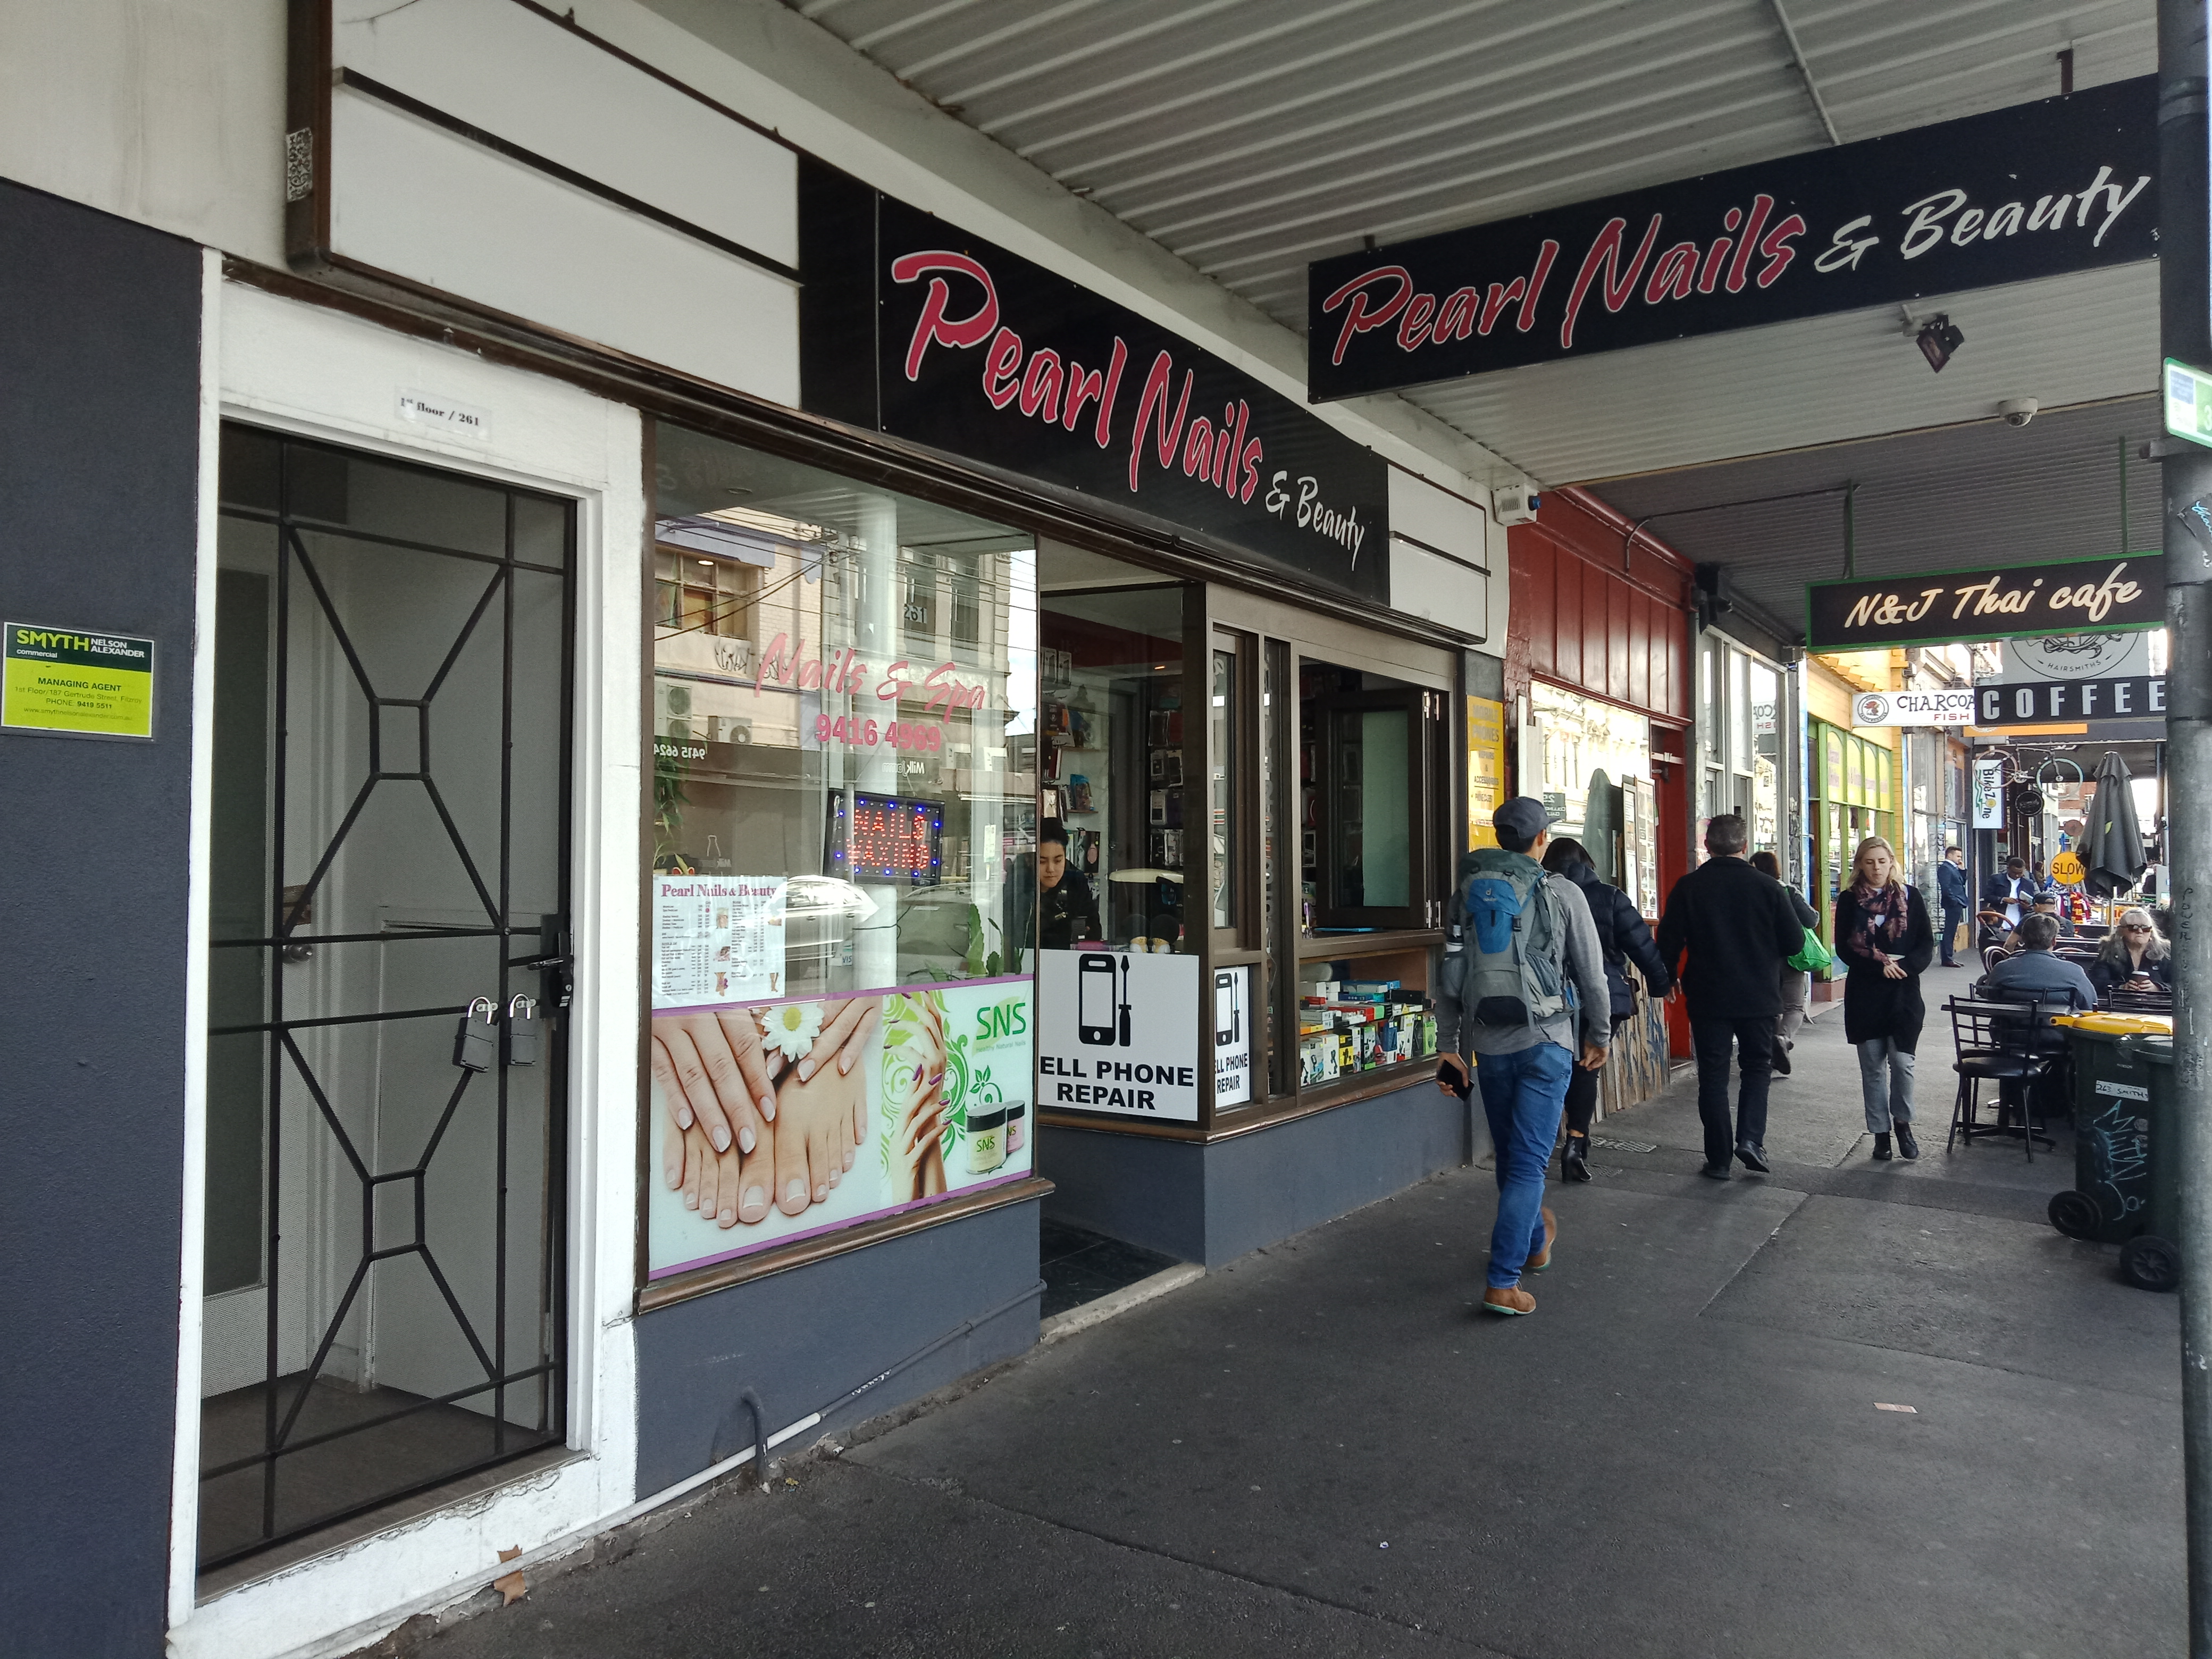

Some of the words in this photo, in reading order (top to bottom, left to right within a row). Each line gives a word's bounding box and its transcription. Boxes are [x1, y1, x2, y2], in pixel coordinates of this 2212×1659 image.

[1322, 237, 1560, 366] Pearl
[1560, 192, 1807, 349] Nails
[1814, 214, 1880, 273] &
[1899, 164, 2151, 262] Beauty
[417, 401, 445, 417] floor
[459, 413, 480, 426] 261
[891, 249, 1128, 450] Pearl
[1129, 349, 1263, 504] Nails
[1265, 470, 1291, 514] &
[1295, 474, 1366, 570] Beauty
[1844, 588, 1943, 628] N&J
[1953, 575, 2043, 619] Thai
[2049, 562, 2142, 622] cafe
[16, 629, 89, 651] SMYTH
[90, 638, 127, 649] NELSON
[16, 648, 57, 658] commercial
[90, 647, 145, 658] ALEXANDER
[2047, 659, 2101, 672] HAIRSMITHS
[38, 677, 88, 689] MANAGING
[753, 632, 867, 698] Nails
[876, 660, 912, 701] &
[923, 662, 986, 725] Spa
[64, 691, 95, 699] Gertrude
[1897, 694, 1975, 711] CHARCOA
[1982, 680, 2166, 720] COFFEE
[816, 714, 877, 747] 9416
[885, 722, 941, 752] 4969
[854, 809, 925, 840] NAILS
[2052, 862, 2084, 875] SLOW
[661, 884, 694, 897] Pearl
[697, 884, 727, 897] Nails
[976, 1002, 1026, 1040] SNS
[1040, 1056, 1087, 1078] ELL
[1096, 1061, 1194, 1087] PHONE
[1226, 1053, 1247, 1071] PHONE
[1217, 1075, 1240, 1094] REPAIR
[2097, 1084, 2112, 1092] 263
[2117, 1088, 2144, 1097] SMITH
[1057, 1083, 1155, 1110] REPAIR
[976, 1136, 995, 1152] SNS
